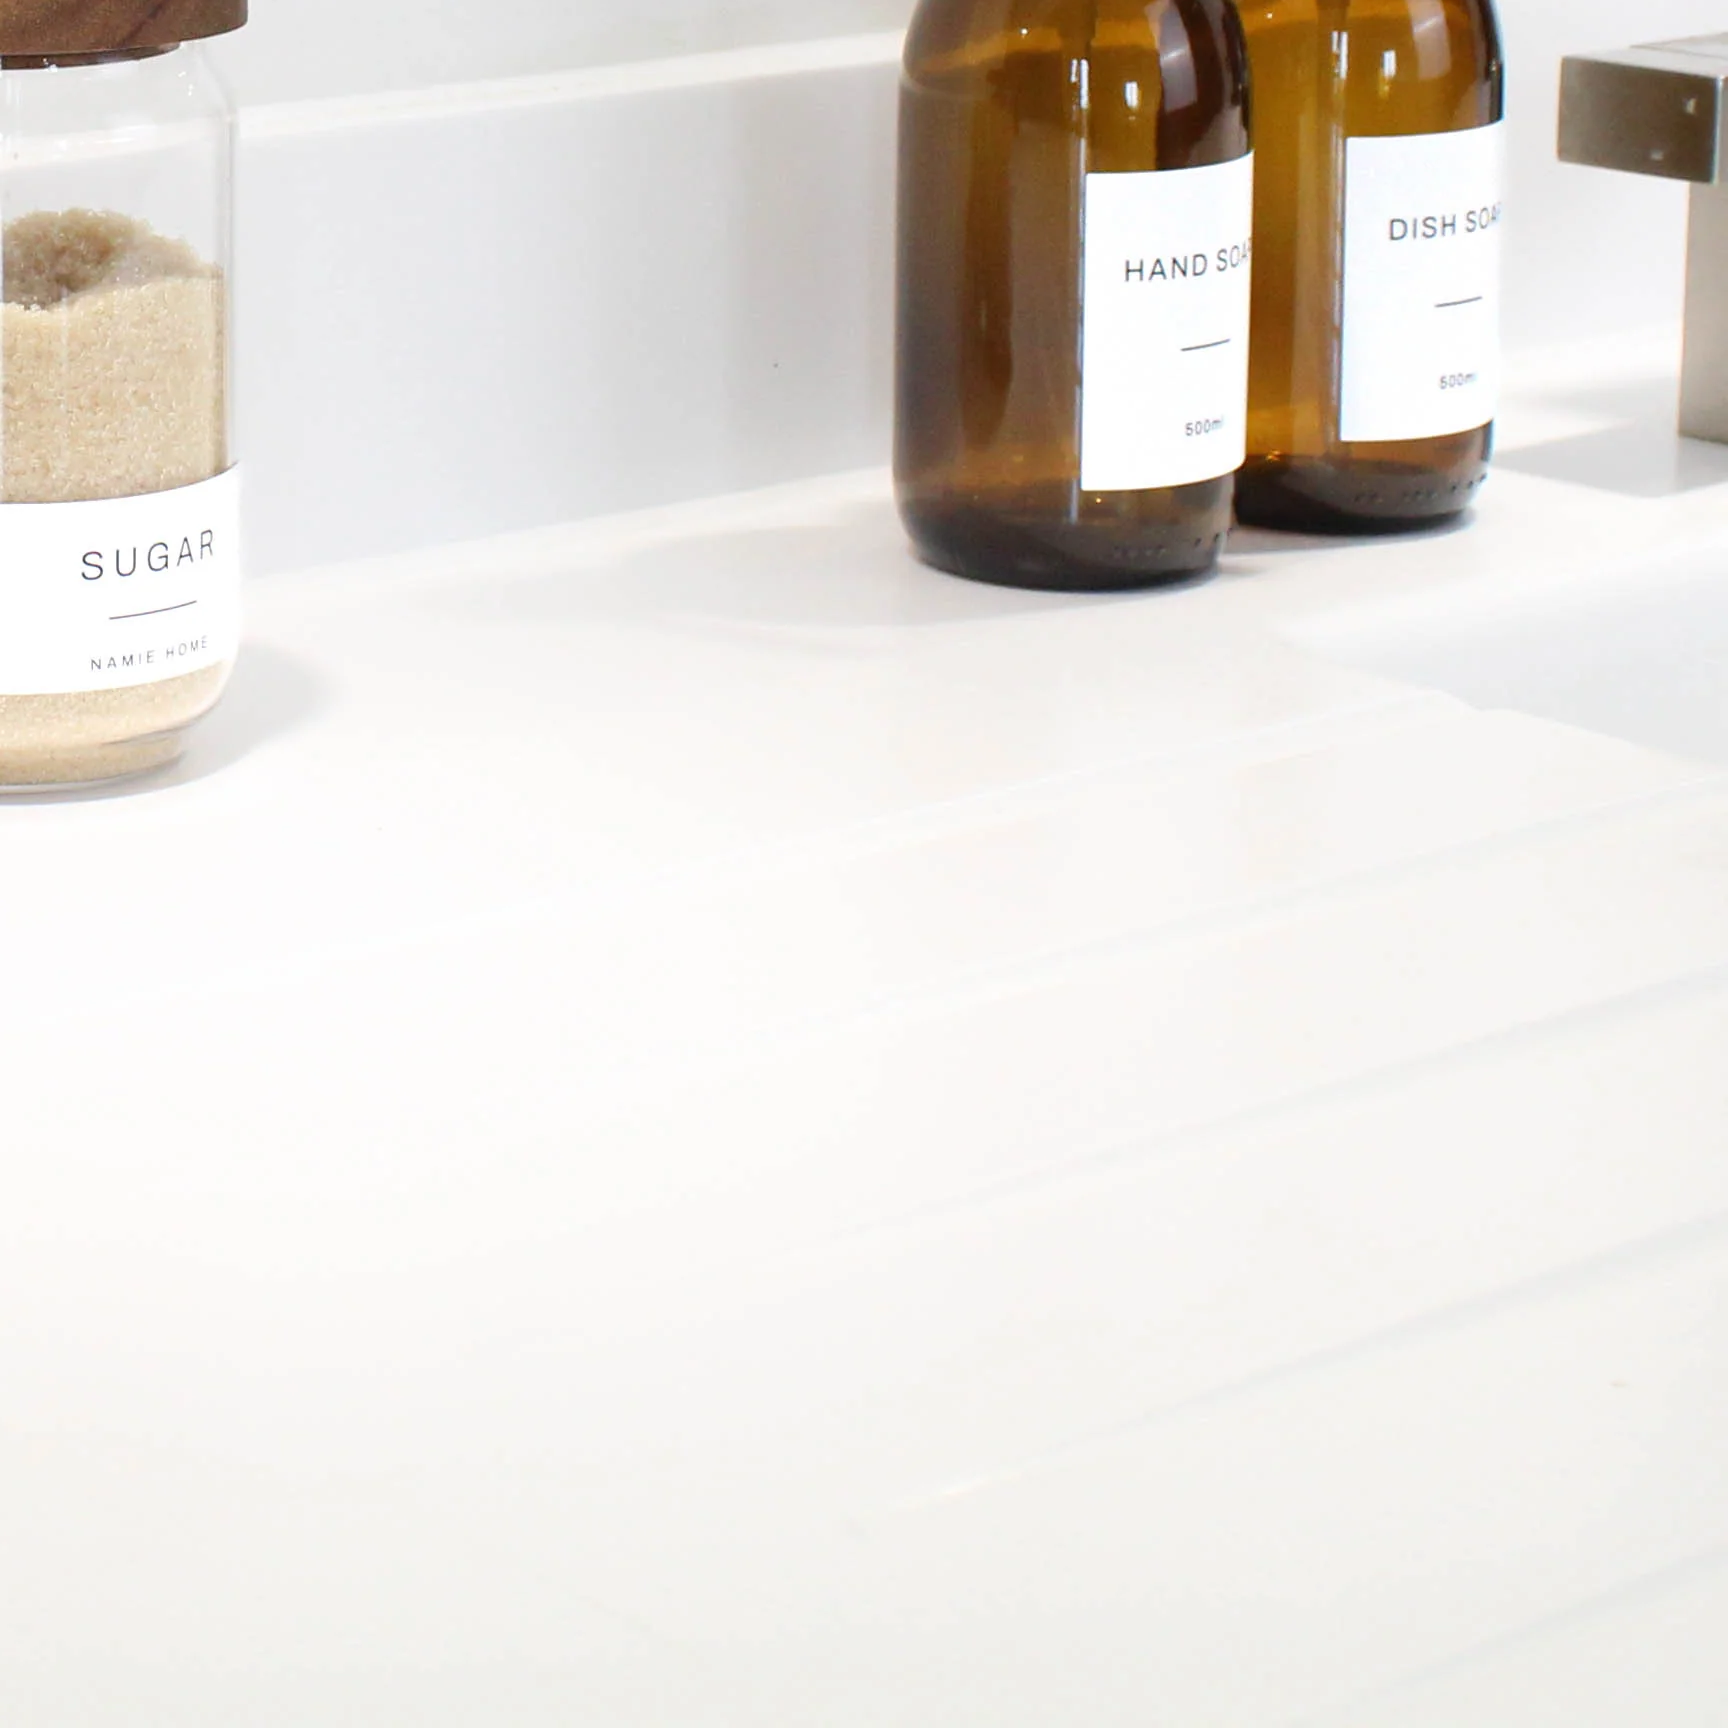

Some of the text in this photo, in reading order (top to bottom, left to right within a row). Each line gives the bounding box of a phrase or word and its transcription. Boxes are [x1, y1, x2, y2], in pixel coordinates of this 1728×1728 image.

[1387, 213, 1458, 242] DISH
[1123, 252, 1209, 283] HAND
[80, 527, 215, 582] SUGAR
[90, 635, 208, 672] NAMIE HOME
